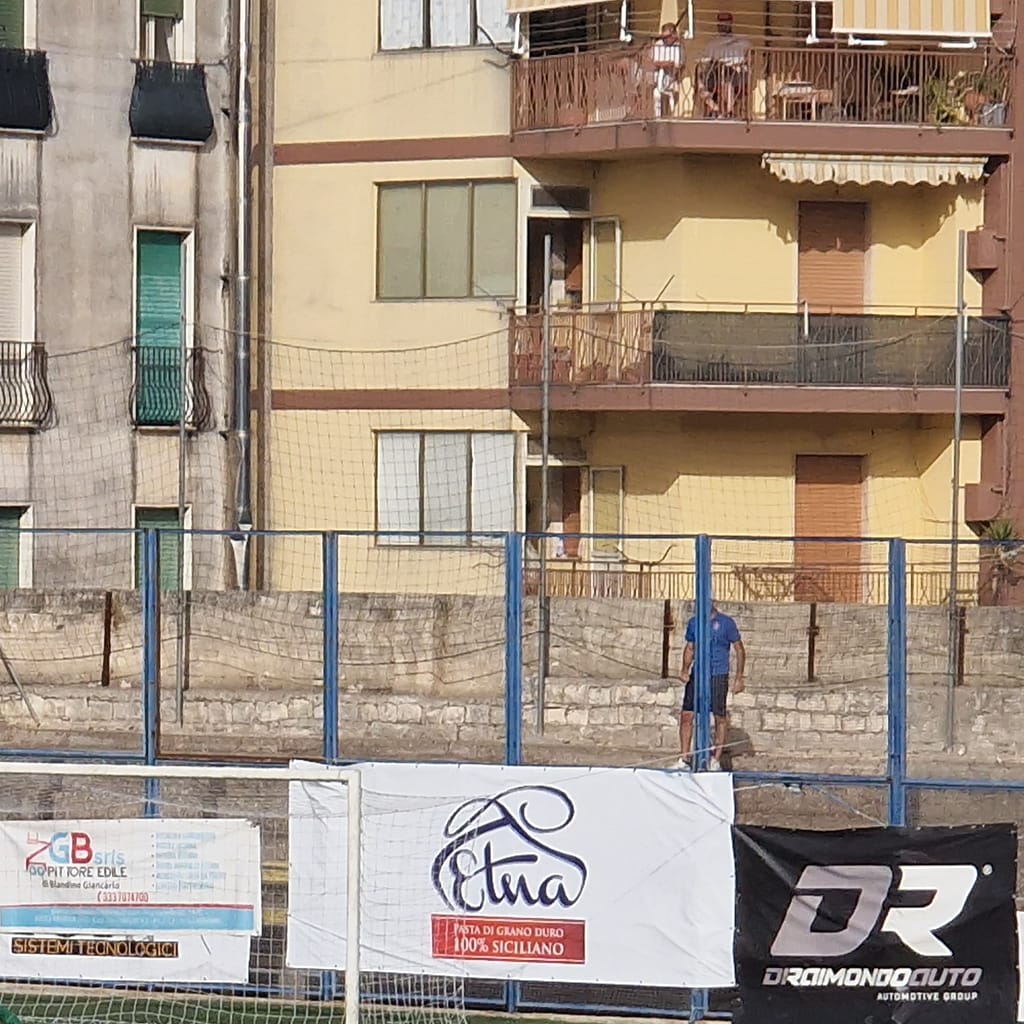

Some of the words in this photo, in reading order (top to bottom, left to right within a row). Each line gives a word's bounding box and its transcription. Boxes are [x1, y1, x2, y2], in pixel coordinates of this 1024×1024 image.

[47, 866, 94, 878] PITTORE
[97, 866, 128, 878] EDILE
[770, 864, 978, 957] DR
[453, 923, 481, 935] PASTA
[483, 925, 495, 936] DI
[497, 926, 532, 938] GRANO
[534, 927, 564, 938] DURO
[13, 938, 73, 955] SISTEMI
[77, 940, 178, 957] TECNOLOGICI
[453, 937, 489, 954] 100%
[492, 939, 565, 956] SICILIANO
[877, 991, 940, 1001] AUTOMOTIVE
[942, 991, 978, 1001] GROUP
